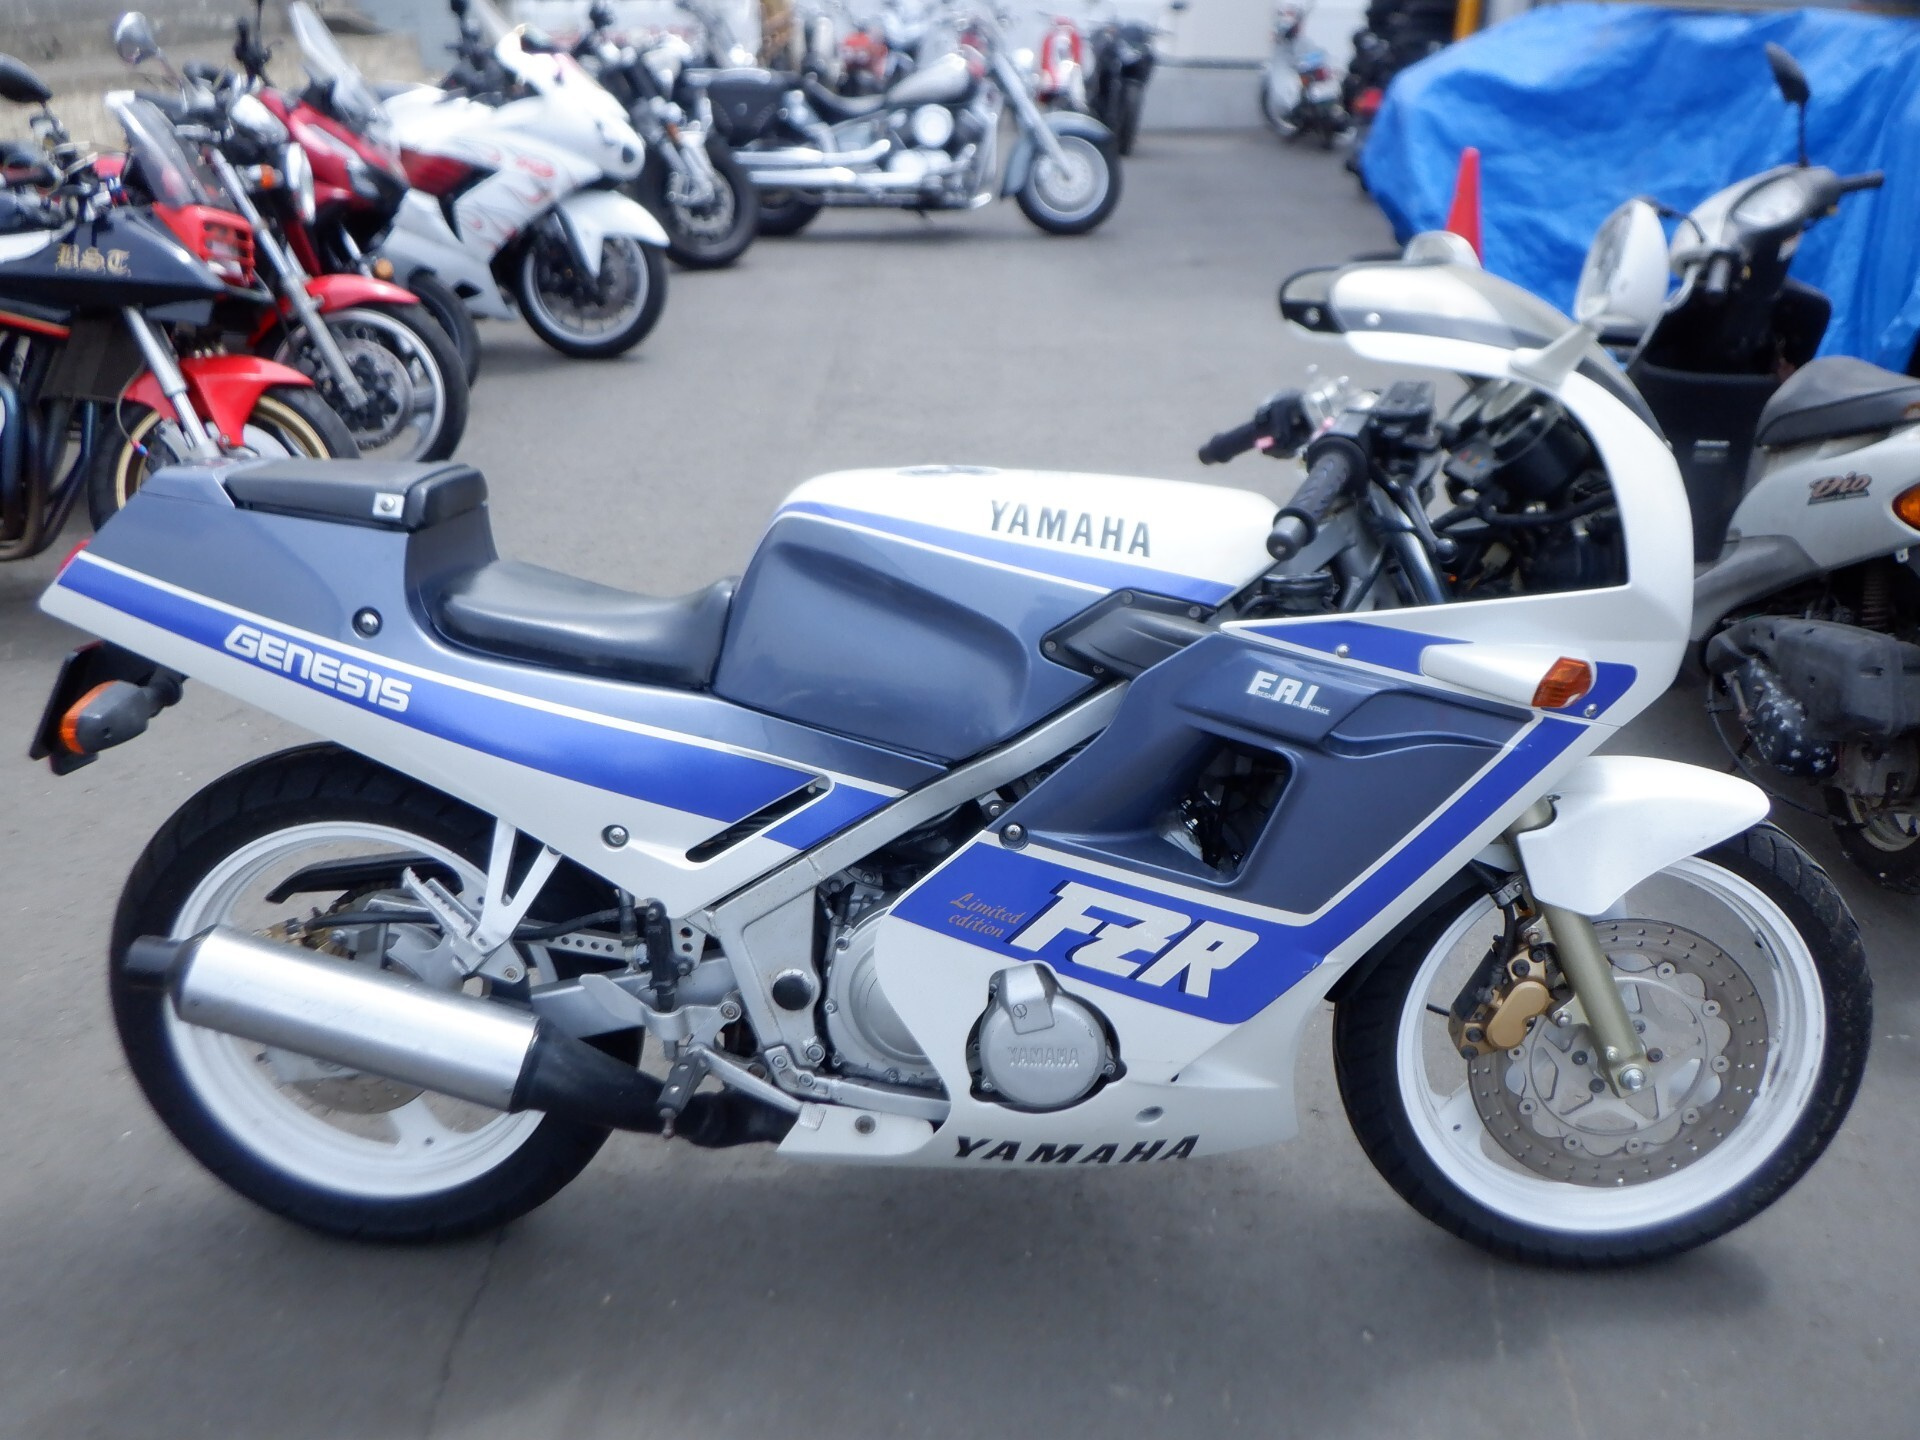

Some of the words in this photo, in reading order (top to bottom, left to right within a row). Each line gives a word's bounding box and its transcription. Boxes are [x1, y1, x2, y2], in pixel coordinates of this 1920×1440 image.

[1808, 470, 1872, 499] Dio
[990, 499, 1151, 558] YAMAHA
[224, 624, 412, 713] GENESIS
[950, 892, 1027, 924] Limited
[948, 914, 1005, 938] edition
[1006, 880, 1260, 998] FZR
[1007, 1046, 1079, 1069] YAMAHA
[954, 1134, 1200, 1164] YAMAHA
